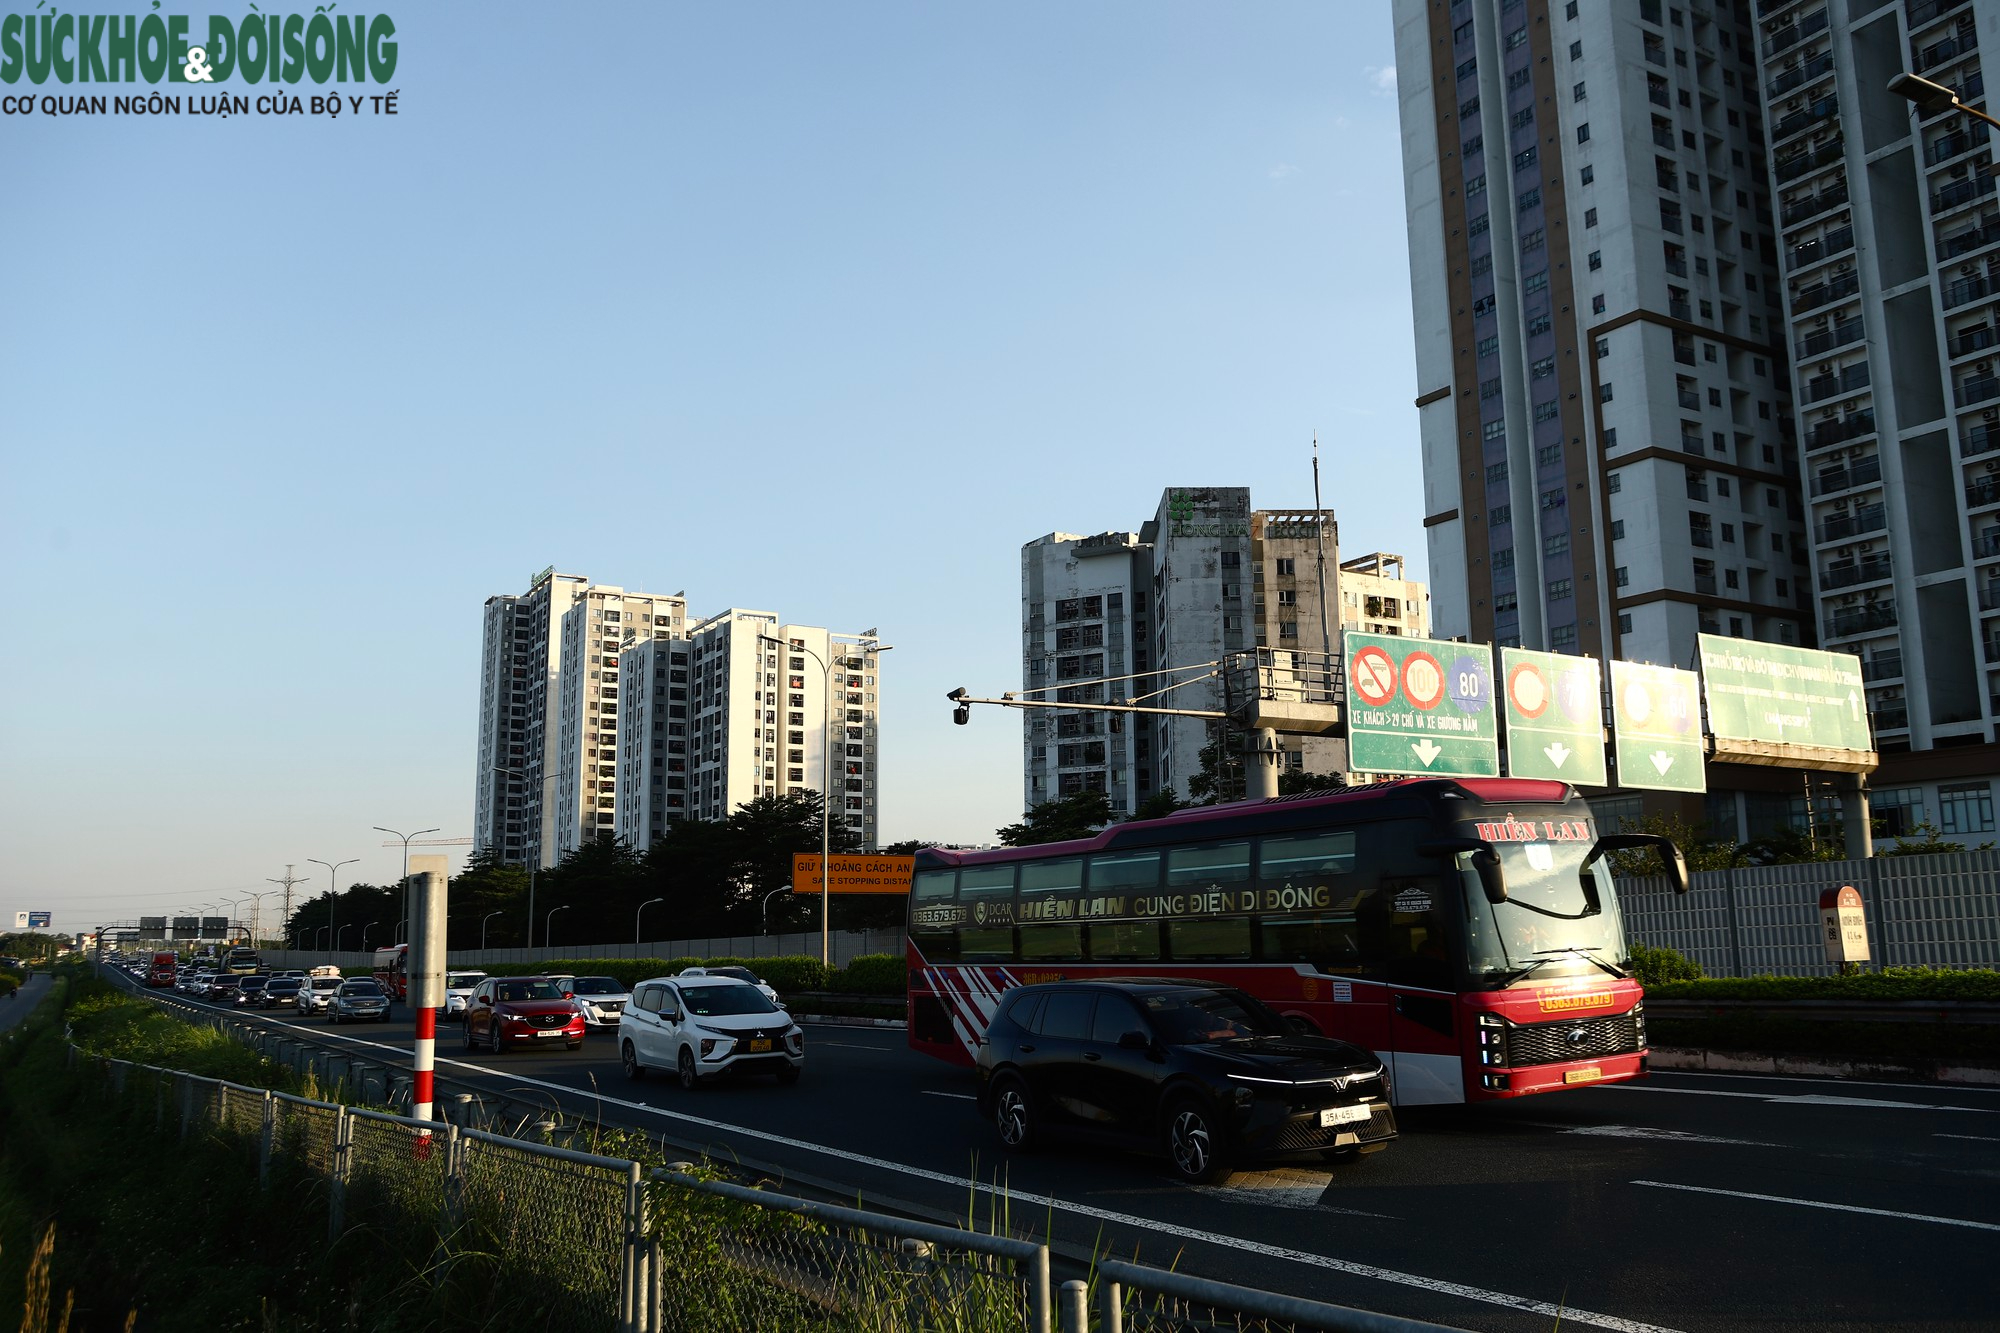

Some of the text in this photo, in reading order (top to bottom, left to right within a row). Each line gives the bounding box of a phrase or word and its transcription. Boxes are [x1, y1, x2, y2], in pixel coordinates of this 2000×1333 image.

[1459, 672, 1479, 698] 80
[1352, 710, 1361, 724] XE
[1363, 708, 1385, 726] KHÁCH
[1416, 712, 1425, 729] VÀ
[1427, 715, 1436, 730] XE
[1475, 812, 1590, 842] HIỀN LAN
[797, 859, 815, 872] GIỮ
[866, 860, 892, 873] CÁCH
[896, 863, 910, 873] AN
[838, 877, 881, 885] STOPPING
[989, 903, 1011, 916] DCAR
[1078, 896, 1127, 918] LAN
[1134, 895, 1185, 916] CUNG
[1241, 890, 1260, 911] DI
[1266, 883, 1330, 913] ĐỘNG
[912, 909, 967, 922] 0363.679.679
